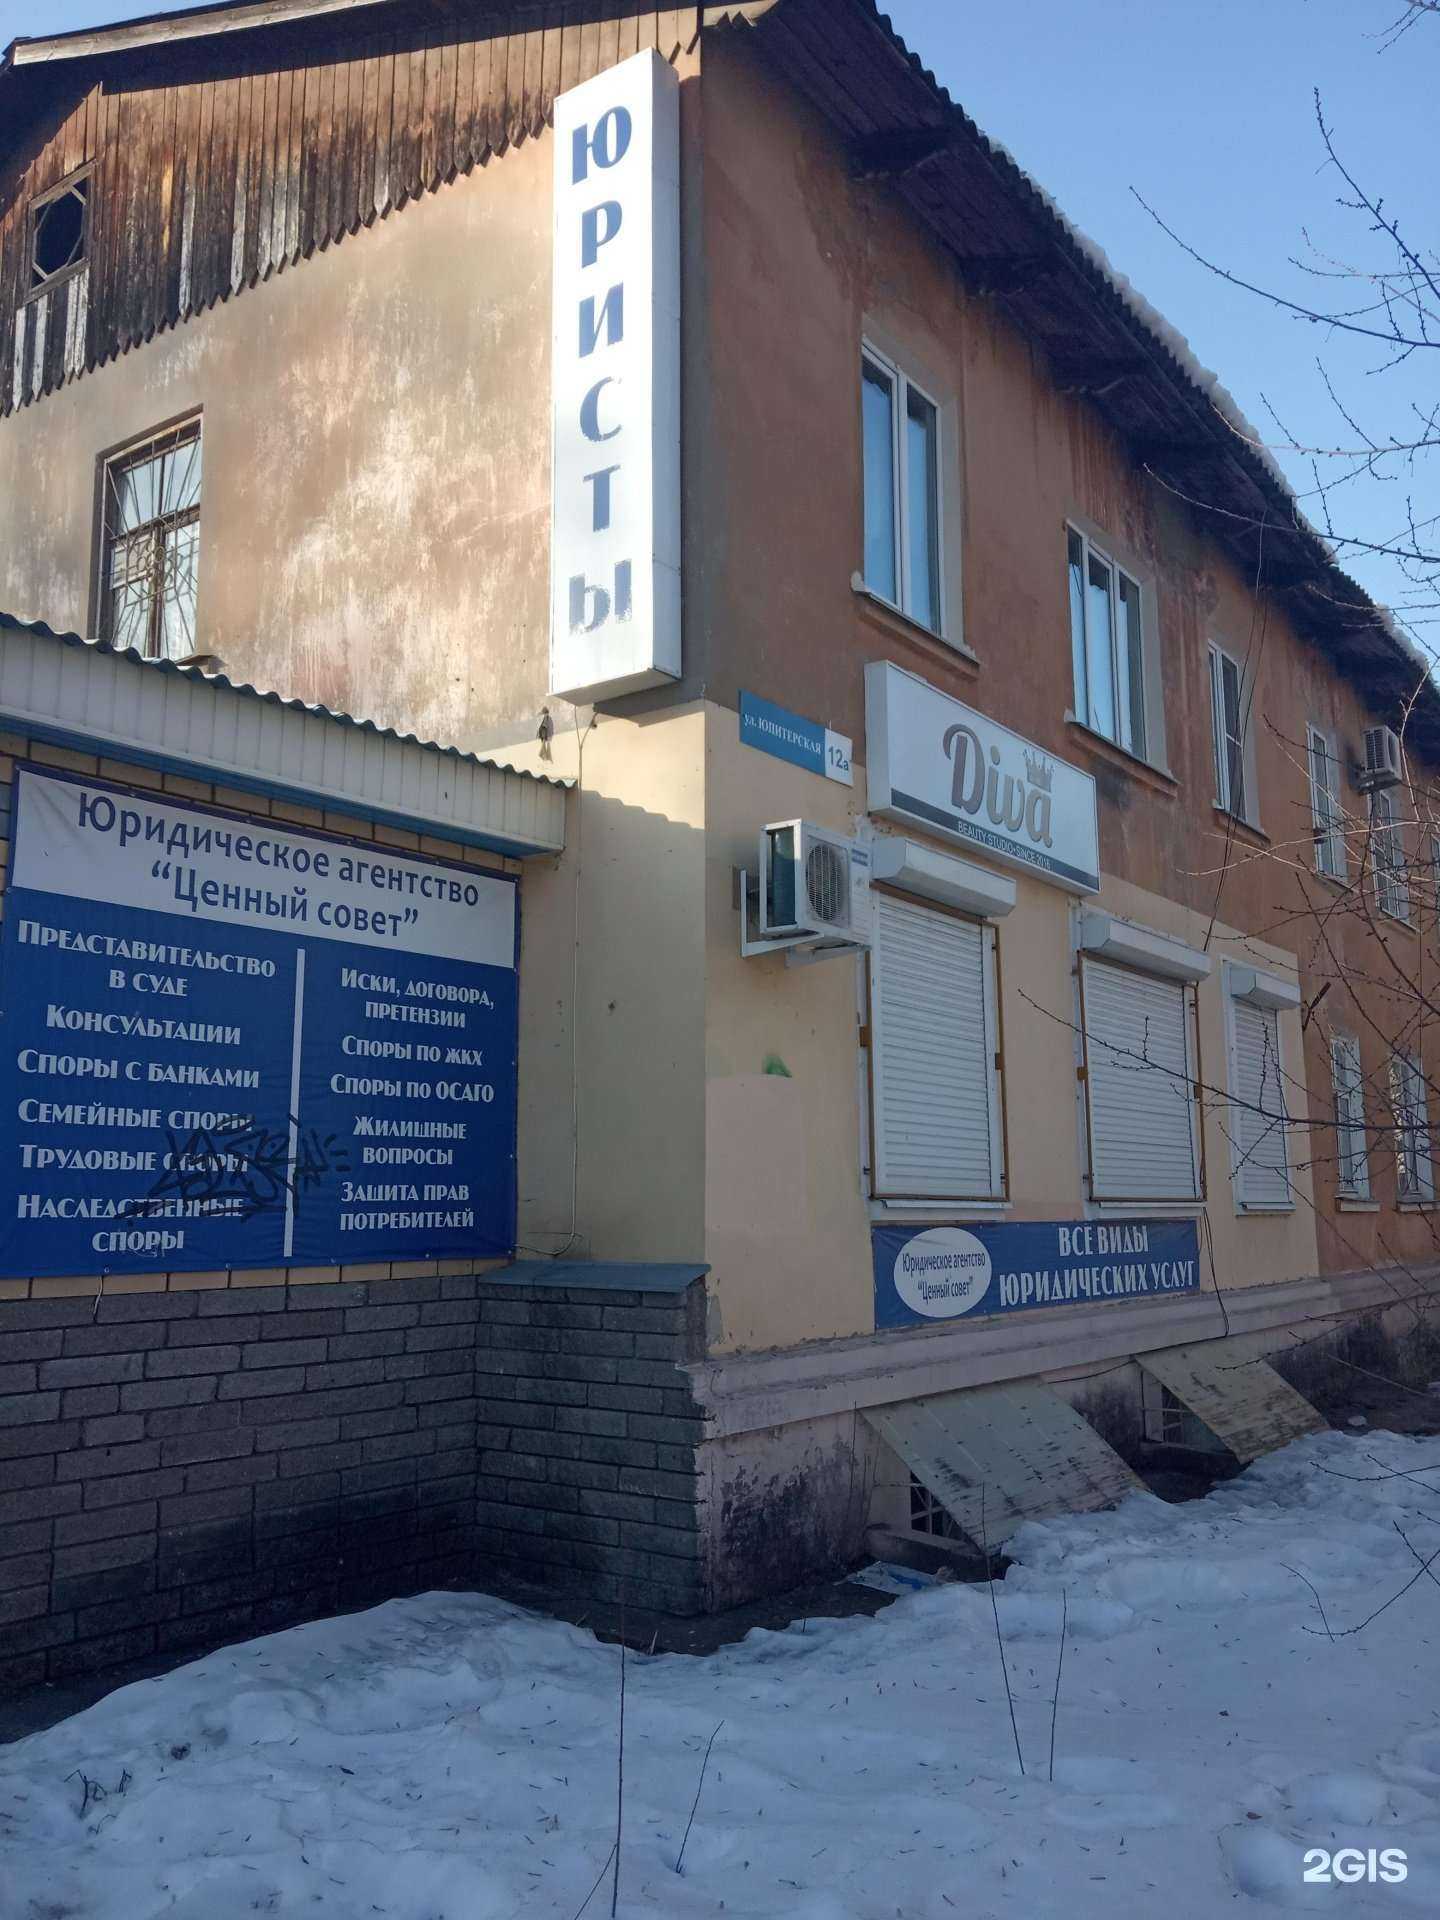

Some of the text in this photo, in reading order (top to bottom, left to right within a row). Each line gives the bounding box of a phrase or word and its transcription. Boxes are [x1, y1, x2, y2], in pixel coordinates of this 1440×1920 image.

[568, 105, 632, 636] ЮРИСТЫ
[759, 717, 822, 755] ЮПИТЕРСКАЯ
[943, 723, 1053, 848] Diwa
[958, 821, 986, 844] BEAUTY
[78, 792, 479, 907] Юридическое агентство
[132, 973, 188, 997] СУДЕ
[365, 1001, 466, 1028] ПРЕТЕНЗИИ
[416, 1044, 441, 1063] ПО
[444, 1047, 483, 1066] ЖКХ
[148, 1063, 260, 1089] БАНКАМИ
[406, 1082, 431, 1099] ПО
[435, 1081, 494, 1103] ОСАГО
[362, 1147, 453, 1165] ВОПРОСЫ
[423, 1184, 469, 1201] ПРАВ
[339, 1207, 474, 1231] ПОТРЕБИТЕЛЕЙ
[1058, 1224, 1149, 1257] ВСЕ ВИДЫ
[902, 1252, 986, 1277] Юридическое агентство
[1000, 1260, 1195, 1307] ЮРИДИЧЕСКИХ УСЛУГ
